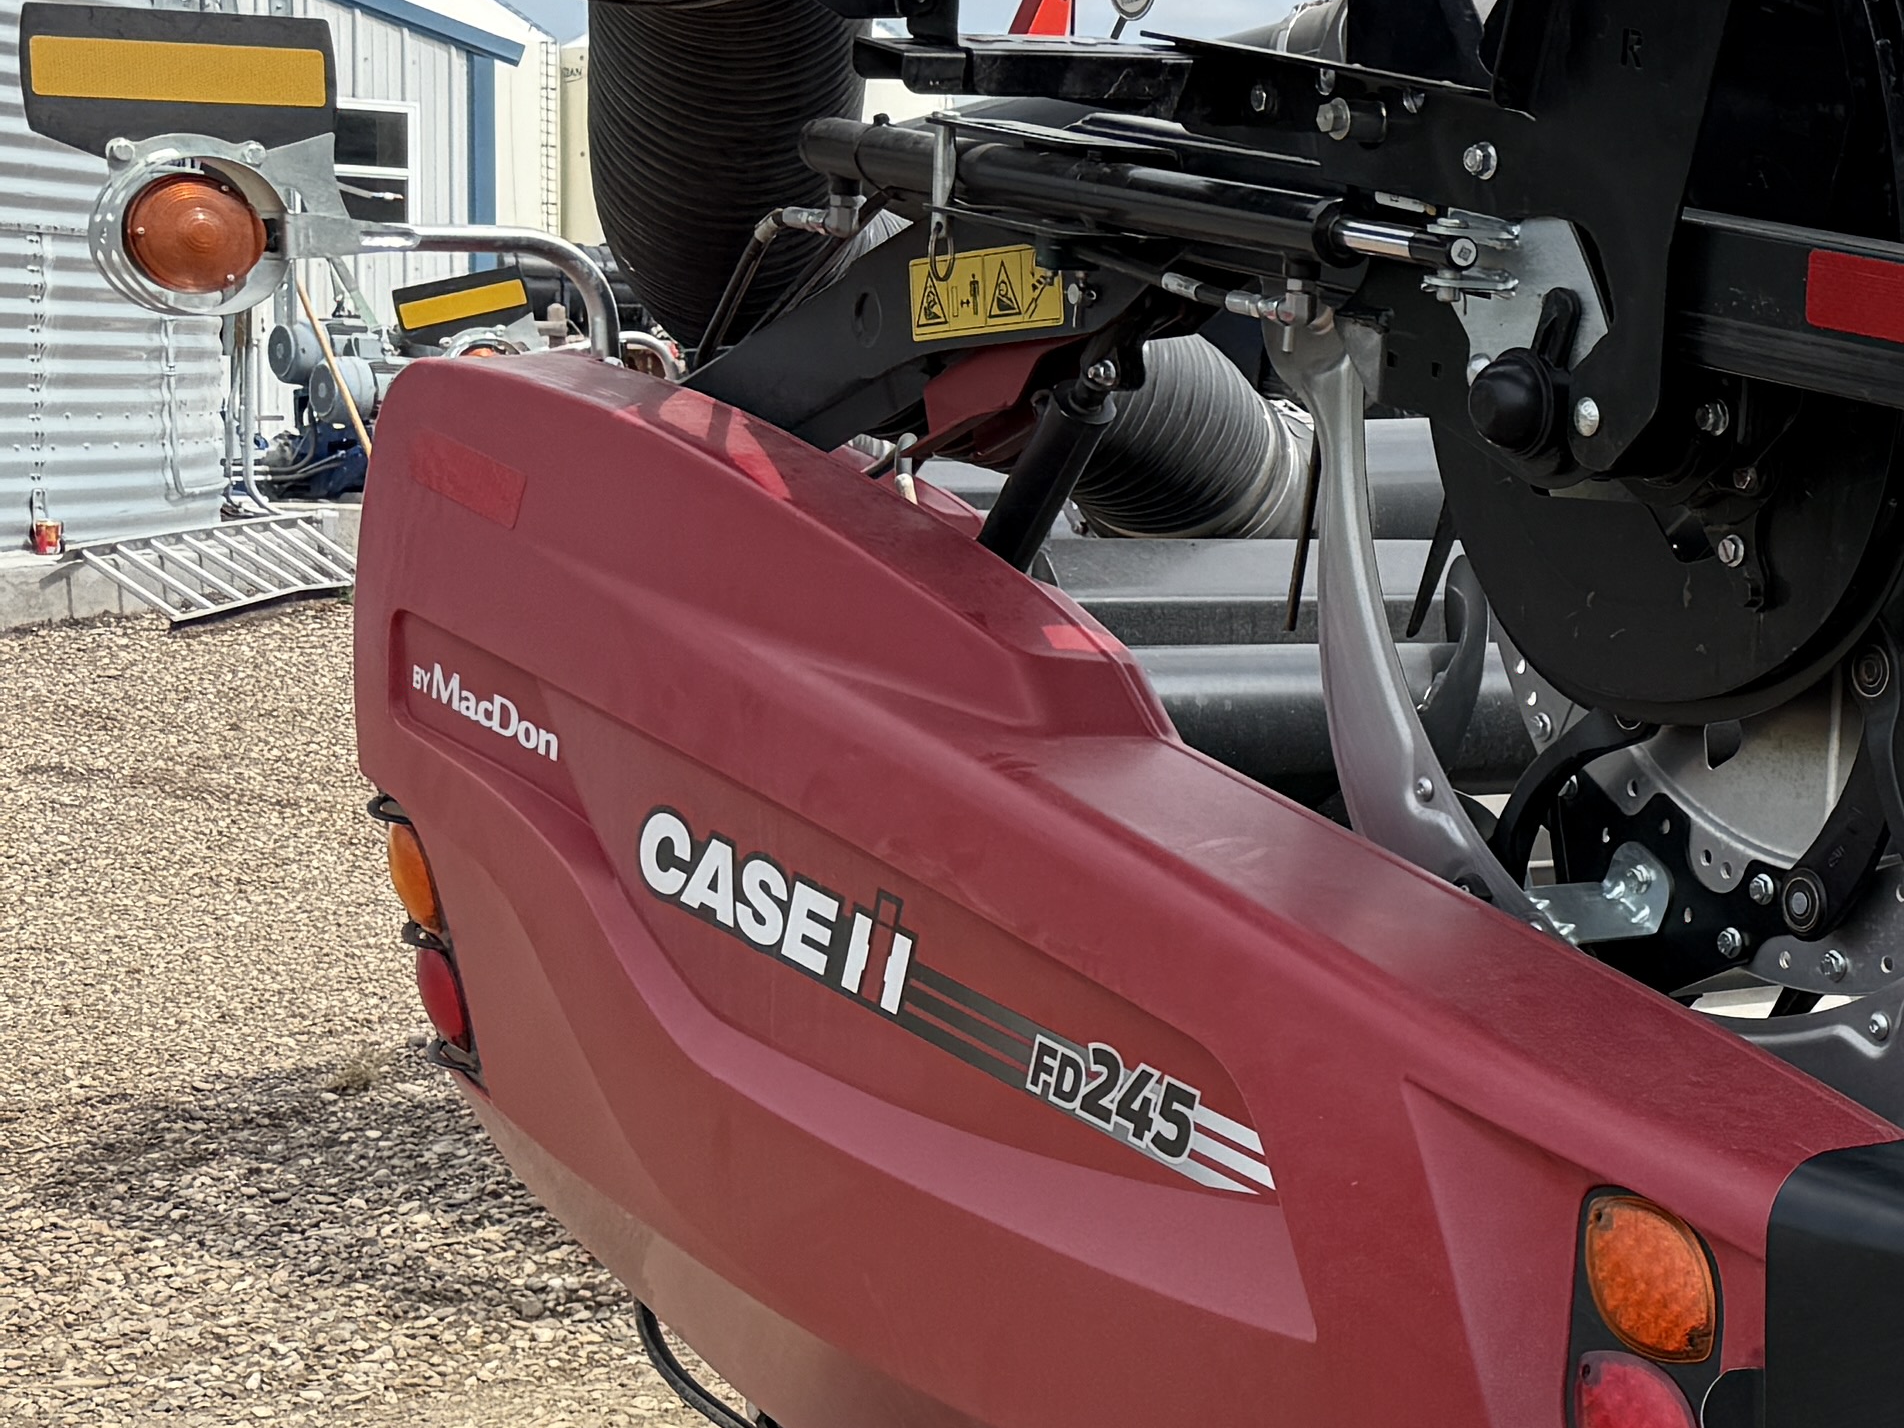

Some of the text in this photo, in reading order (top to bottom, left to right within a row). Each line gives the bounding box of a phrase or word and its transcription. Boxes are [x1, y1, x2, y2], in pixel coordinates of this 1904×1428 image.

[412, 662, 559, 762] BY MacDon
[1025, 1033, 1201, 1165] FD245
